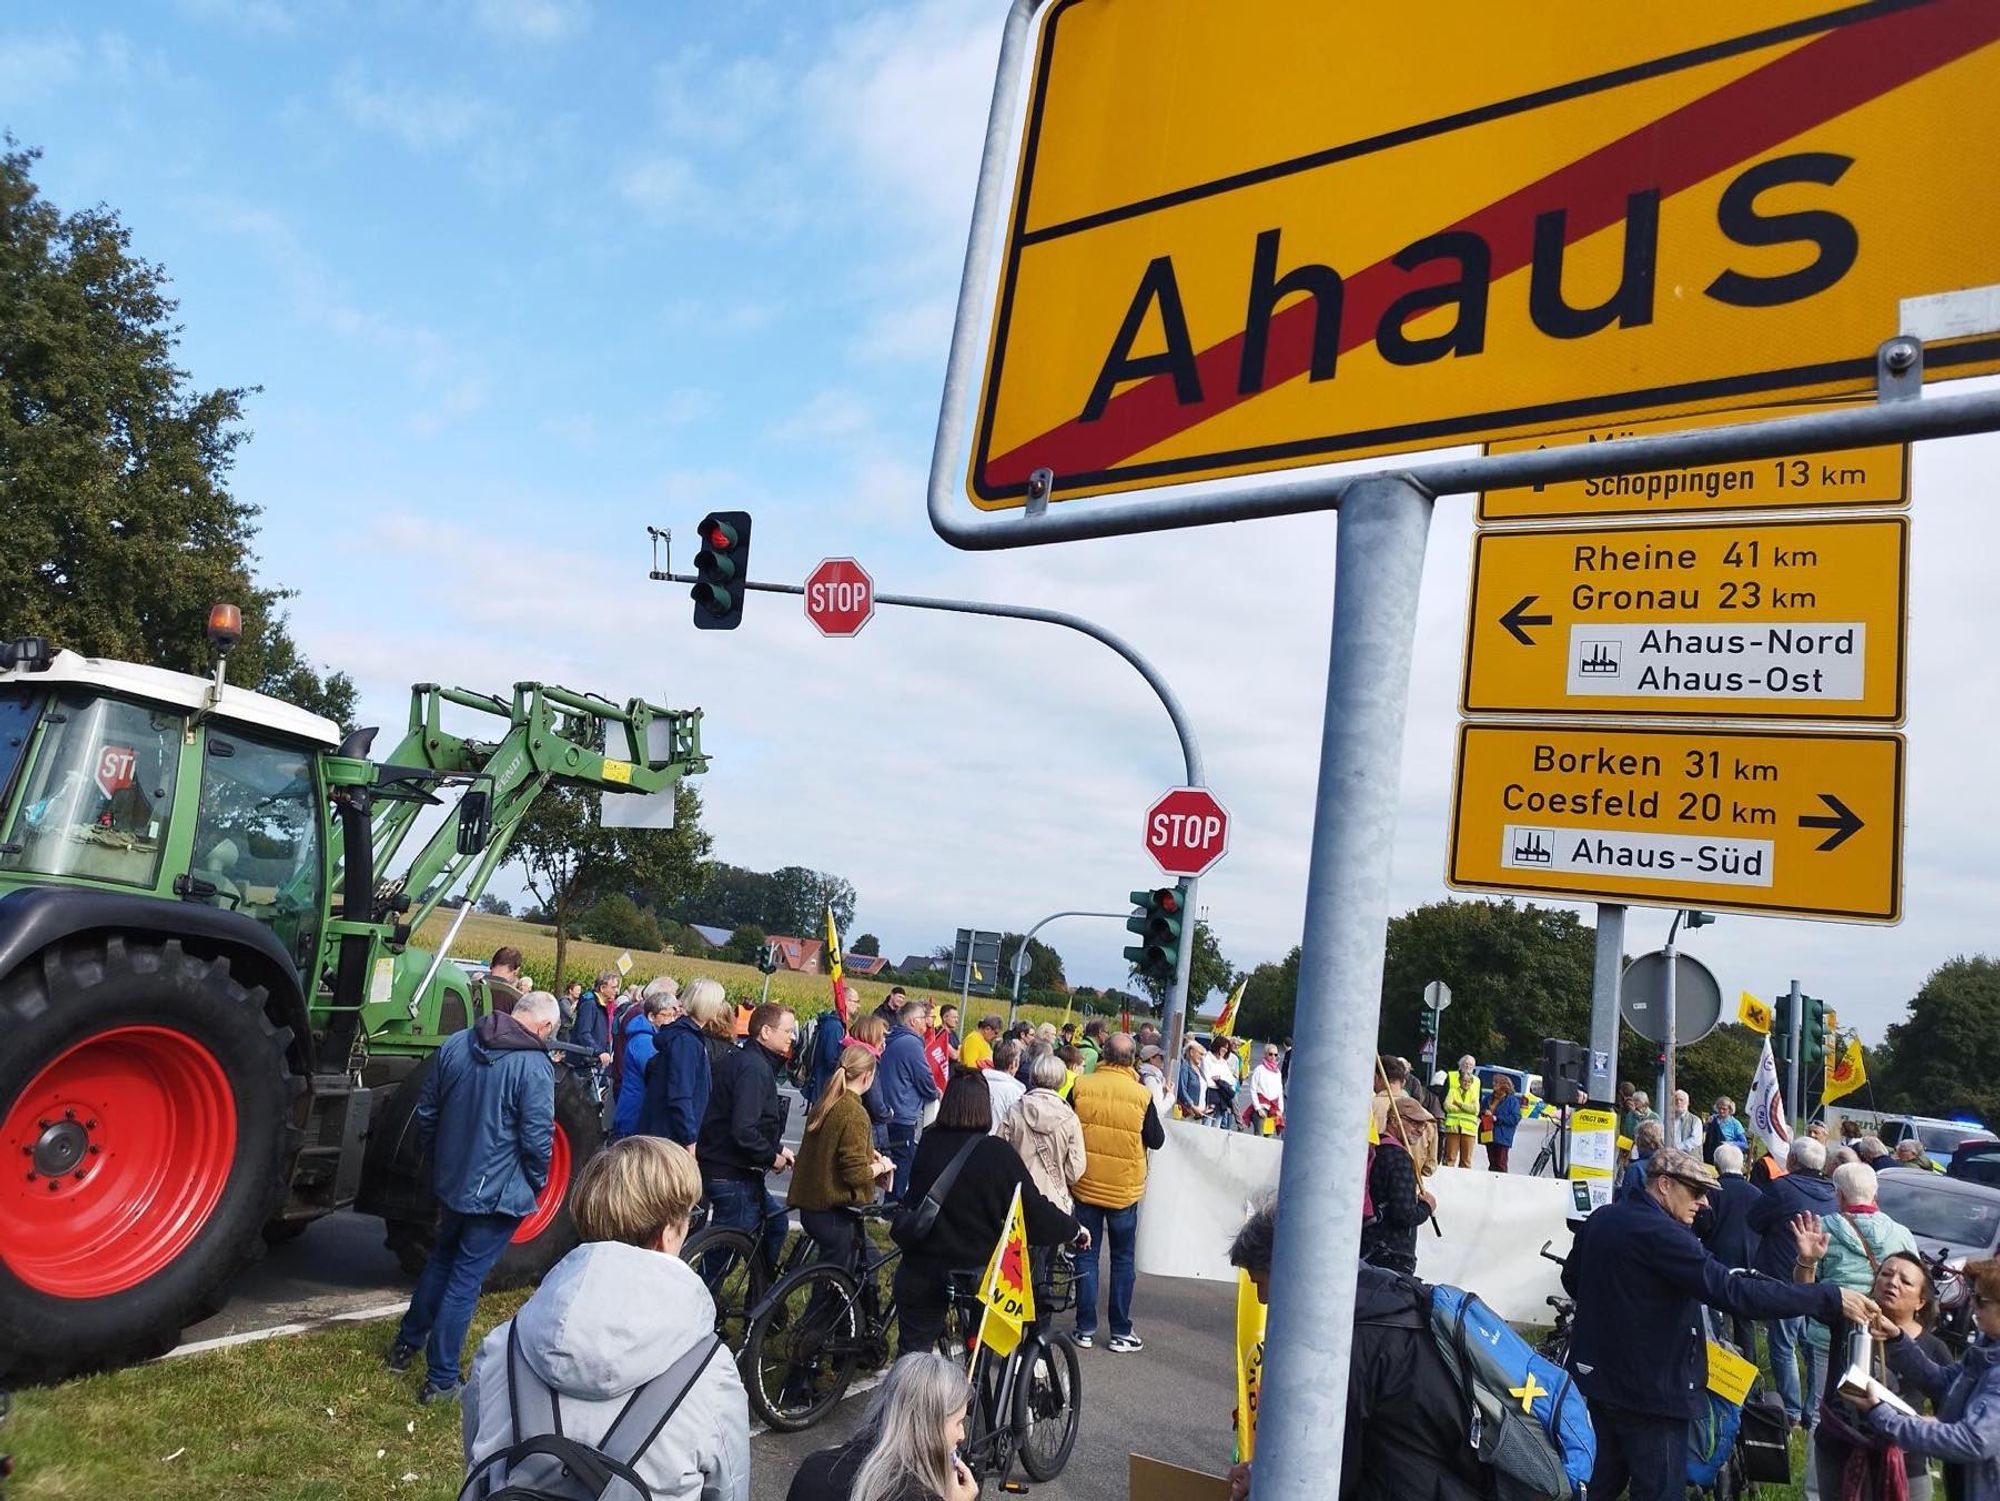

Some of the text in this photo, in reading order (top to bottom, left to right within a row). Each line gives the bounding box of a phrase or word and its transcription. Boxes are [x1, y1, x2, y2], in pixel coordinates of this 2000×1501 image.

[1078, 152, 1860, 424] Ahaus
[1775, 460, 1809, 487] 13
[1822, 466, 1866, 485] km
[1573, 541, 1818, 571] Rheine 41 km
[811, 582, 867, 613] STOP
[1572, 582, 1816, 610] Gronau 23 km
[1639, 629, 1854, 654] Ahaus-Nord
[1637, 666, 1823, 692] Ahaus-Ost
[102, 753, 136, 781] ST
[1533, 745, 1779, 781] Borken 31 km
[1503, 783, 1777, 824] Coesfeld 20 km
[1151, 813, 1222, 849] STOP
[1571, 838, 1763, 876] Ahaus-Süd
